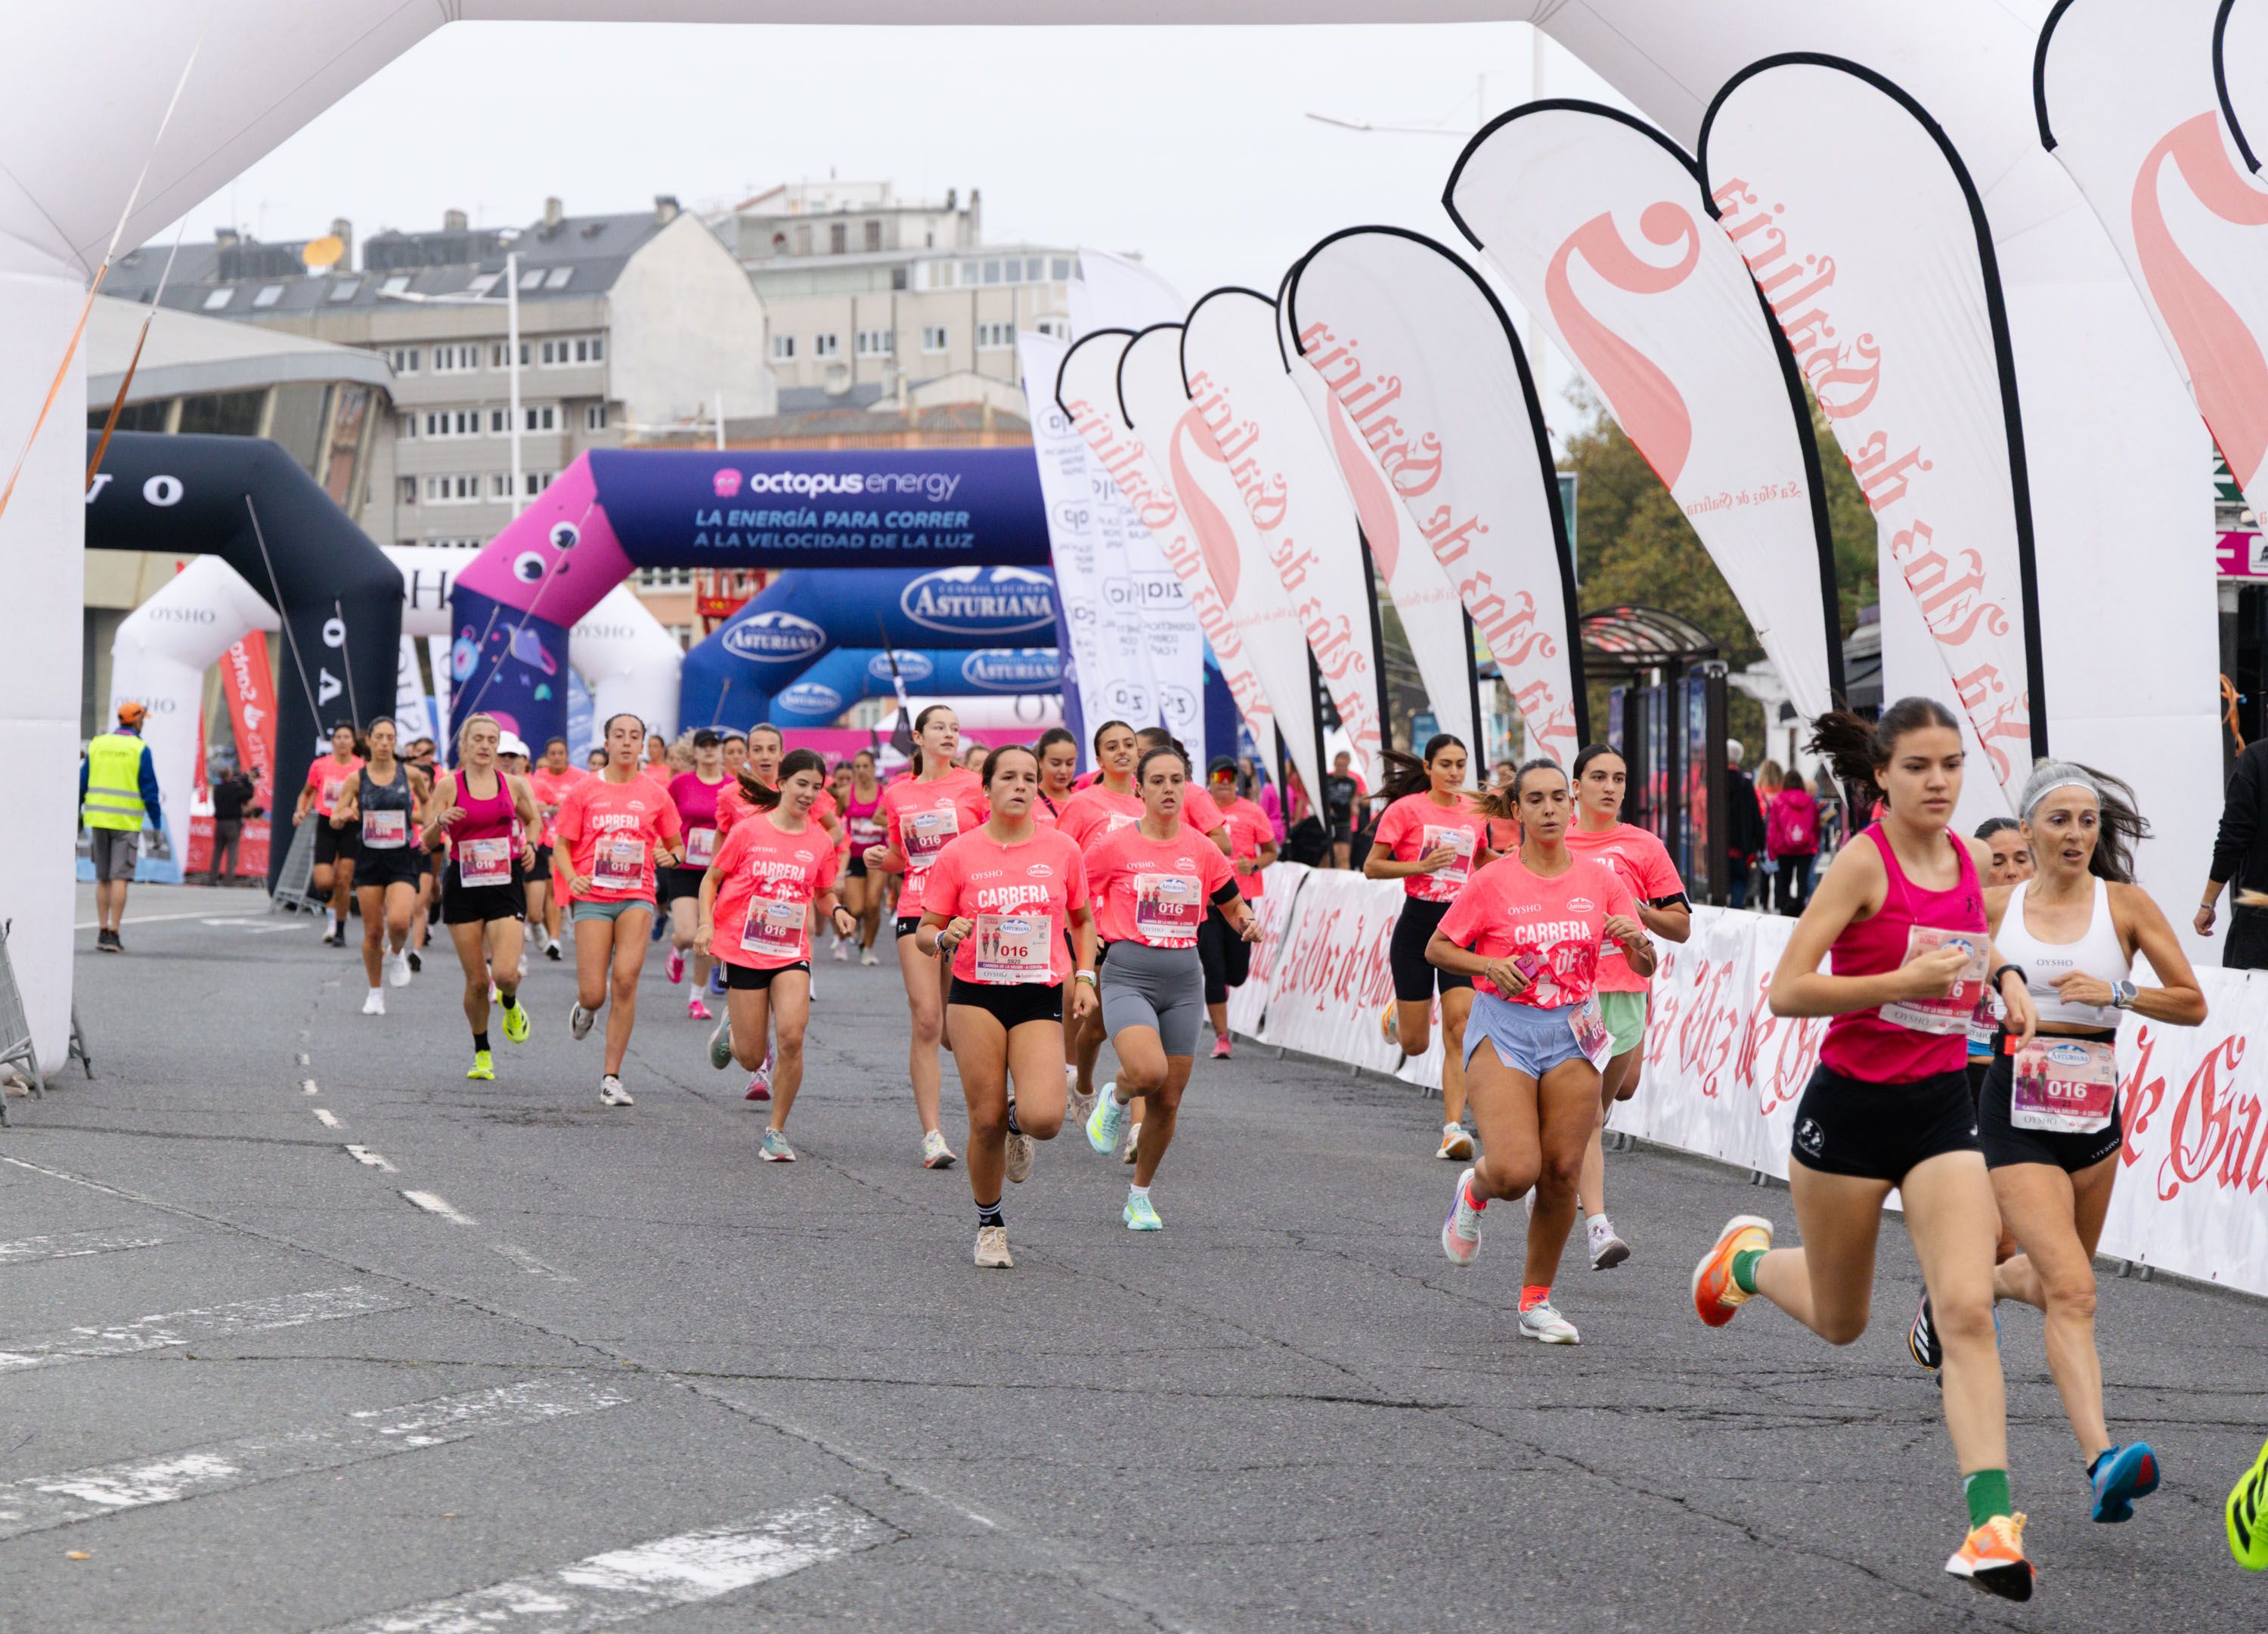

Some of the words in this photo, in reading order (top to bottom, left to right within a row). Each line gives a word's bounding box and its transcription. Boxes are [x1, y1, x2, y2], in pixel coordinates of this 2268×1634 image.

[695, 508, 722, 527] LA
[727, 505, 817, 528] ENERGÍA
[822, 510, 878, 529] PARA
[884, 511, 970, 529] CORRER
[694, 532, 710, 547] A
[714, 533, 740, 548] LA
[745, 532, 866, 549] VELOCIDAD
[869, 534, 898, 549] DE
[902, 534, 928, 550] LA
[934, 534, 975, 550] LUZ
[915, 585, 1053, 616] ASTURIANA
[150, 606, 216, 625] OYSHO
[593, 814, 640, 830] CARRERA
[919, 835, 941, 846] 016
[752, 860, 806, 882] CARRERA
[1126, 861, 1155, 870] OYSHO
[971, 870, 1003, 881] OYSHO
[978, 885, 1051, 909] CARRERA
[1158, 903, 1184, 915] 016
[1507, 904, 1541, 916] OYSHO
[764, 925, 786, 936] 016
[1001, 924, 1030, 932] ASTURIANA
[1514, 920, 1592, 945] CARRERA
[1000, 945, 1029, 957] 016
[2036, 958, 2073, 967] OYSHO
[1894, 1010, 1930, 1025] OYSHO
[1591, 1019, 1603, 1040] 016
[1970, 1028, 1991, 1040] YSHO
[2051, 1052, 2089, 1062] ASTURIANA
[2048, 1081, 2087, 1099] 016
[2024, 1115, 2057, 1125] OYSHO
